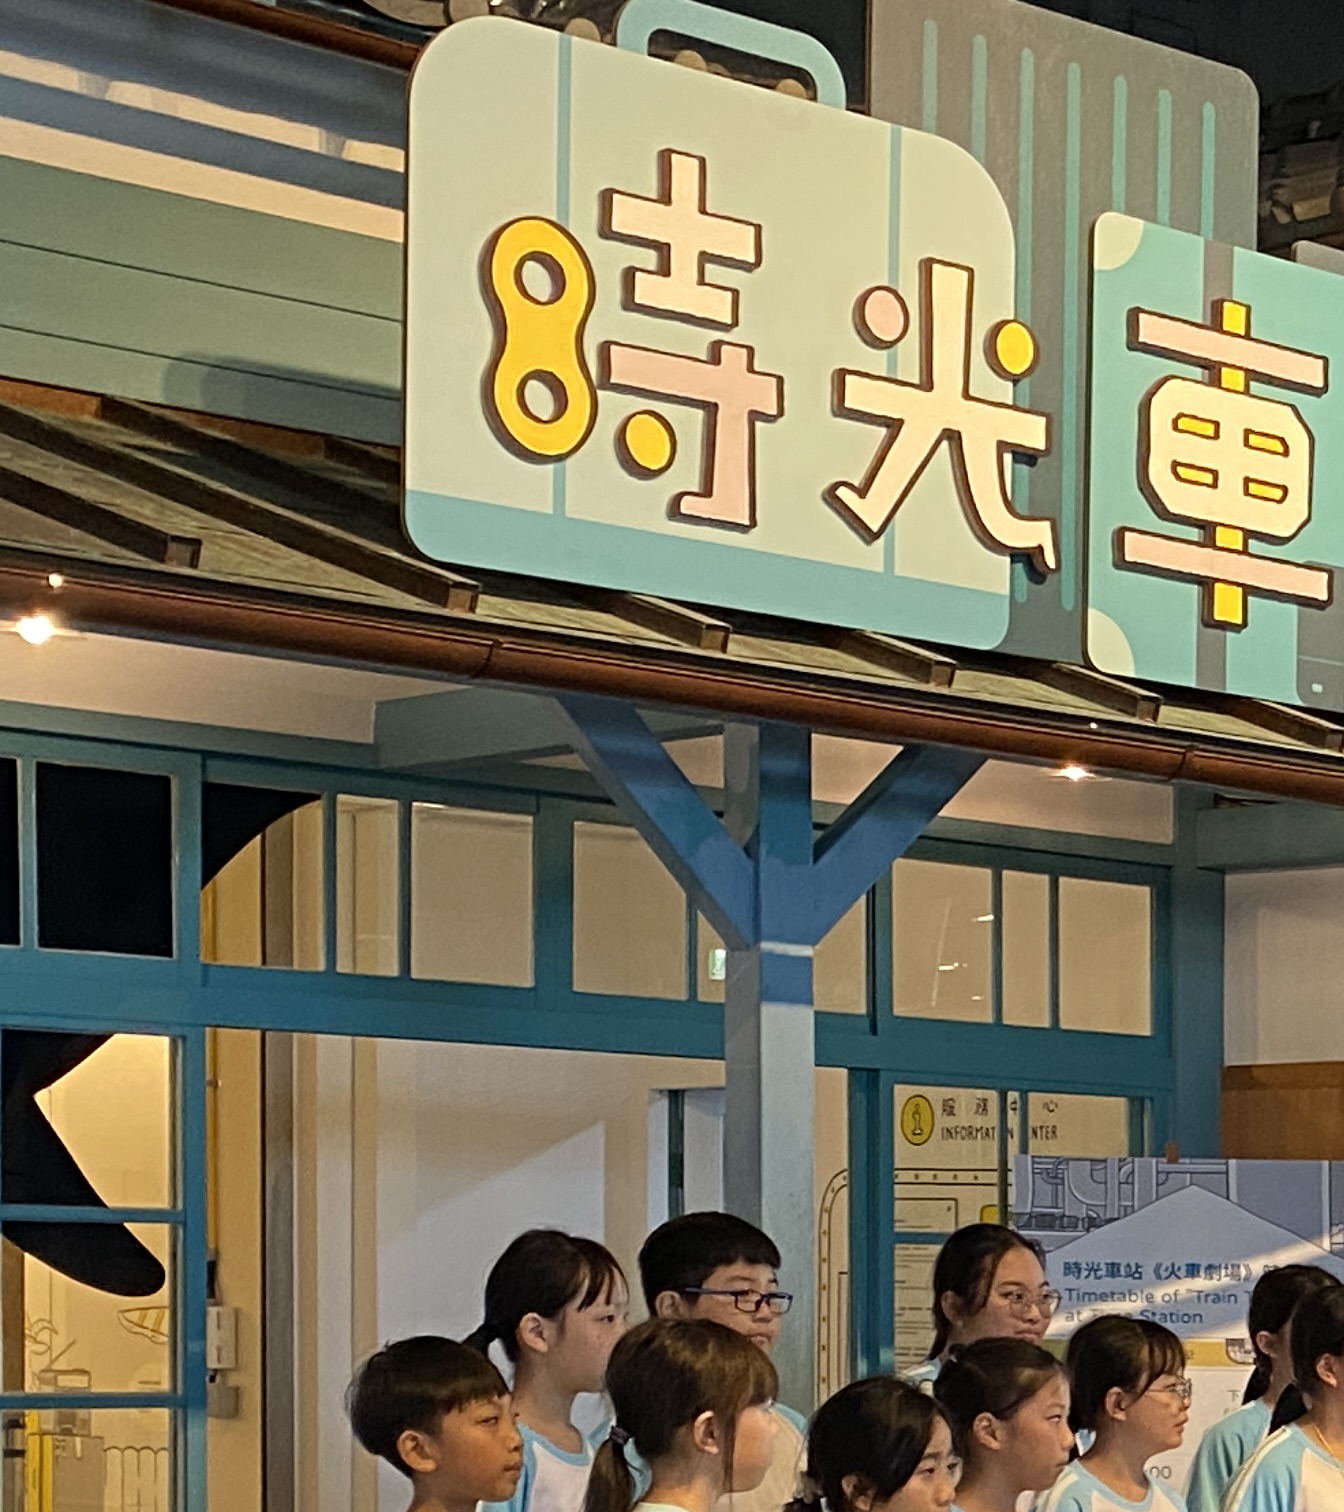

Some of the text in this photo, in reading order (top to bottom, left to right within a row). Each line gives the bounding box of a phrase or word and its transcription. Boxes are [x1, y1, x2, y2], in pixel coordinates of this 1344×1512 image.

[1063, 1261, 1279, 1282] 時光車站《火車劇場》
[1065, 1288, 1154, 1304] Timetable
[1161, 1288, 1181, 1304] of
[1140, 1309, 1204, 1325] Station
